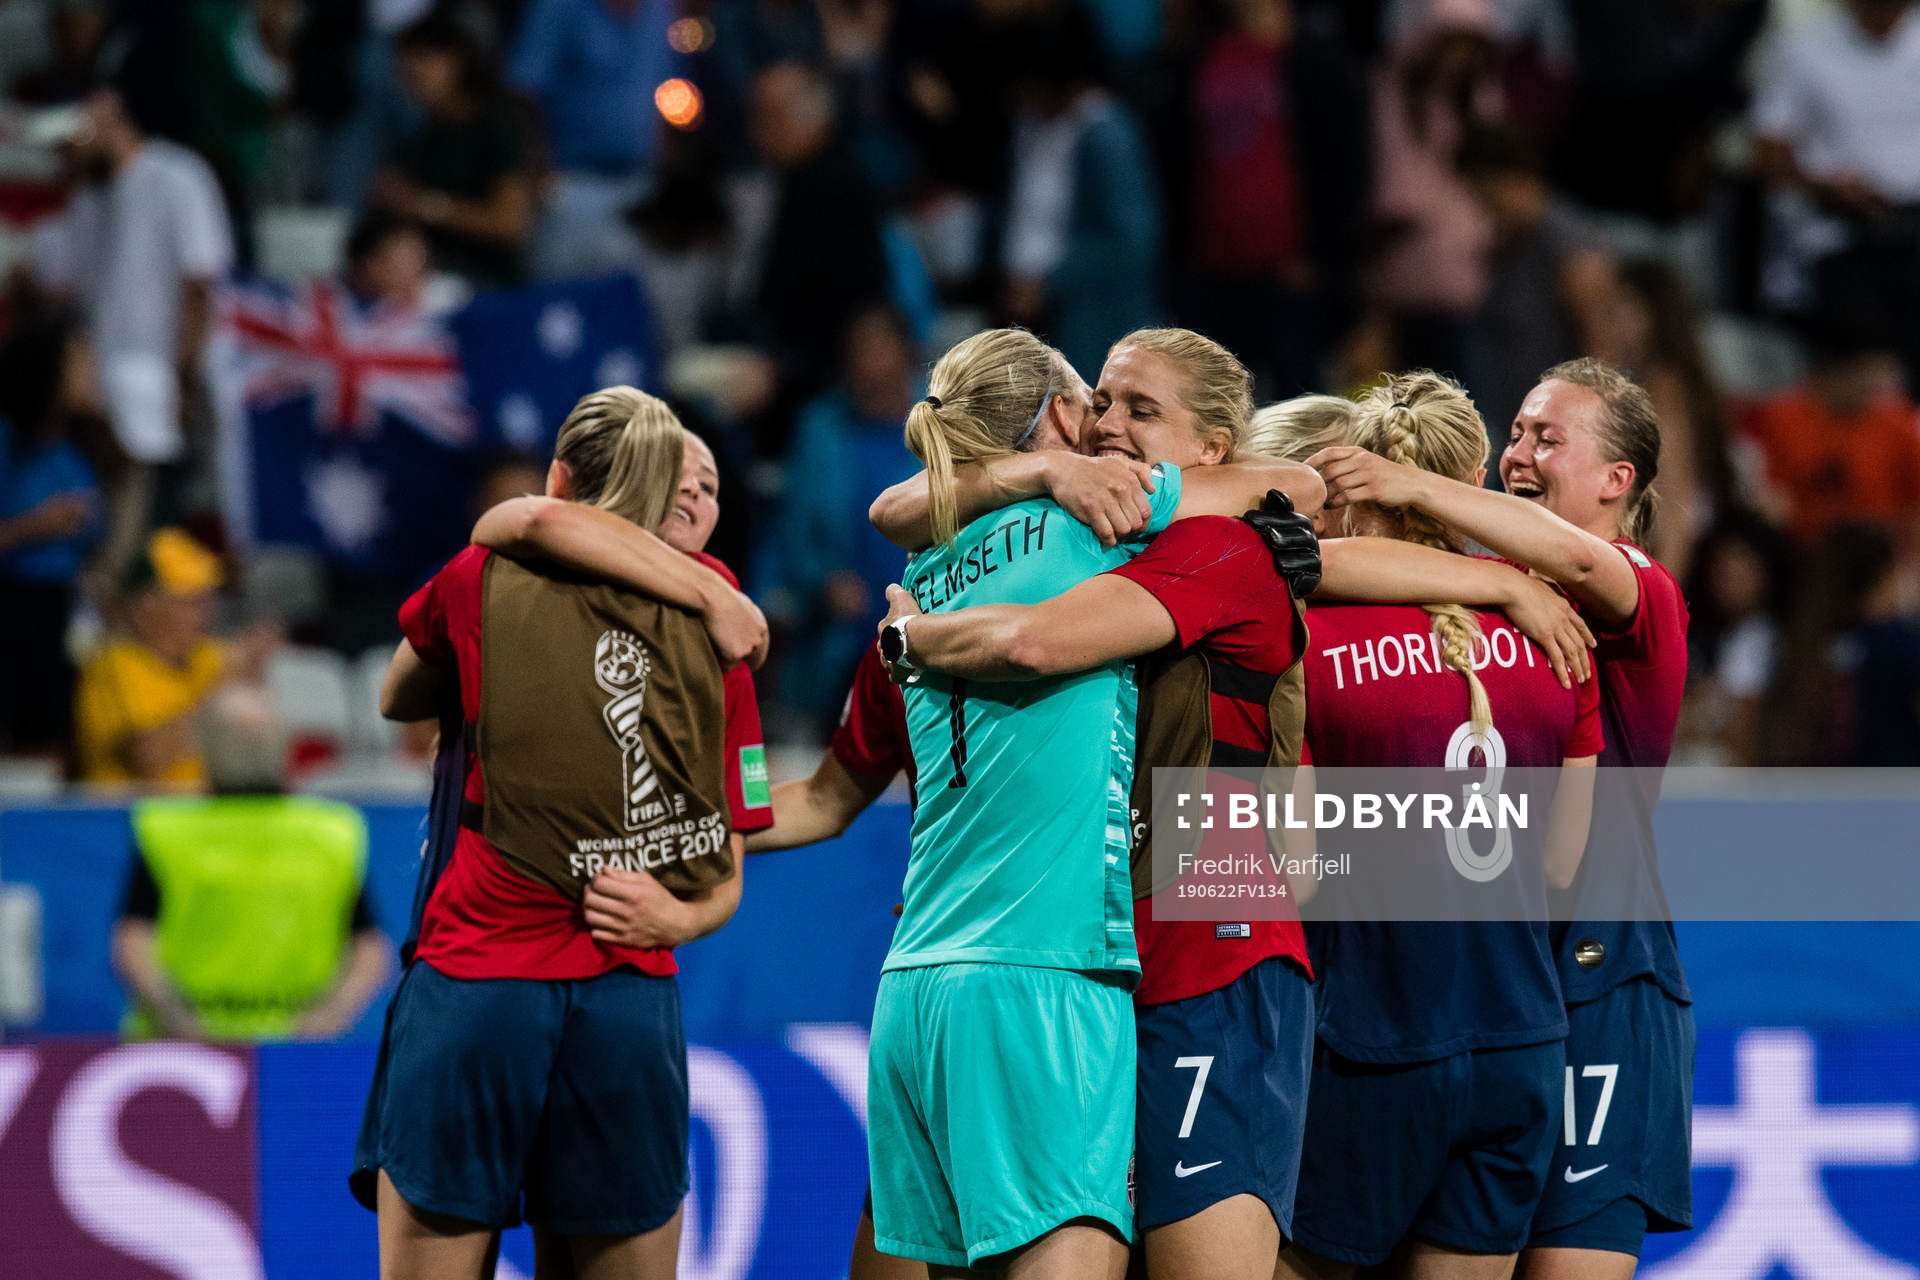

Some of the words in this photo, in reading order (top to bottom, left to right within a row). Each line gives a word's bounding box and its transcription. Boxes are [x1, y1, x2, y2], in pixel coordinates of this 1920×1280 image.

[630, 801, 666, 824] FIFA
[647, 819, 696, 841] WORLD
[569, 838, 678, 878] FRANCE
[1174, 1055, 1215, 1138] 7
[1563, 1063, 1620, 1146] 17
